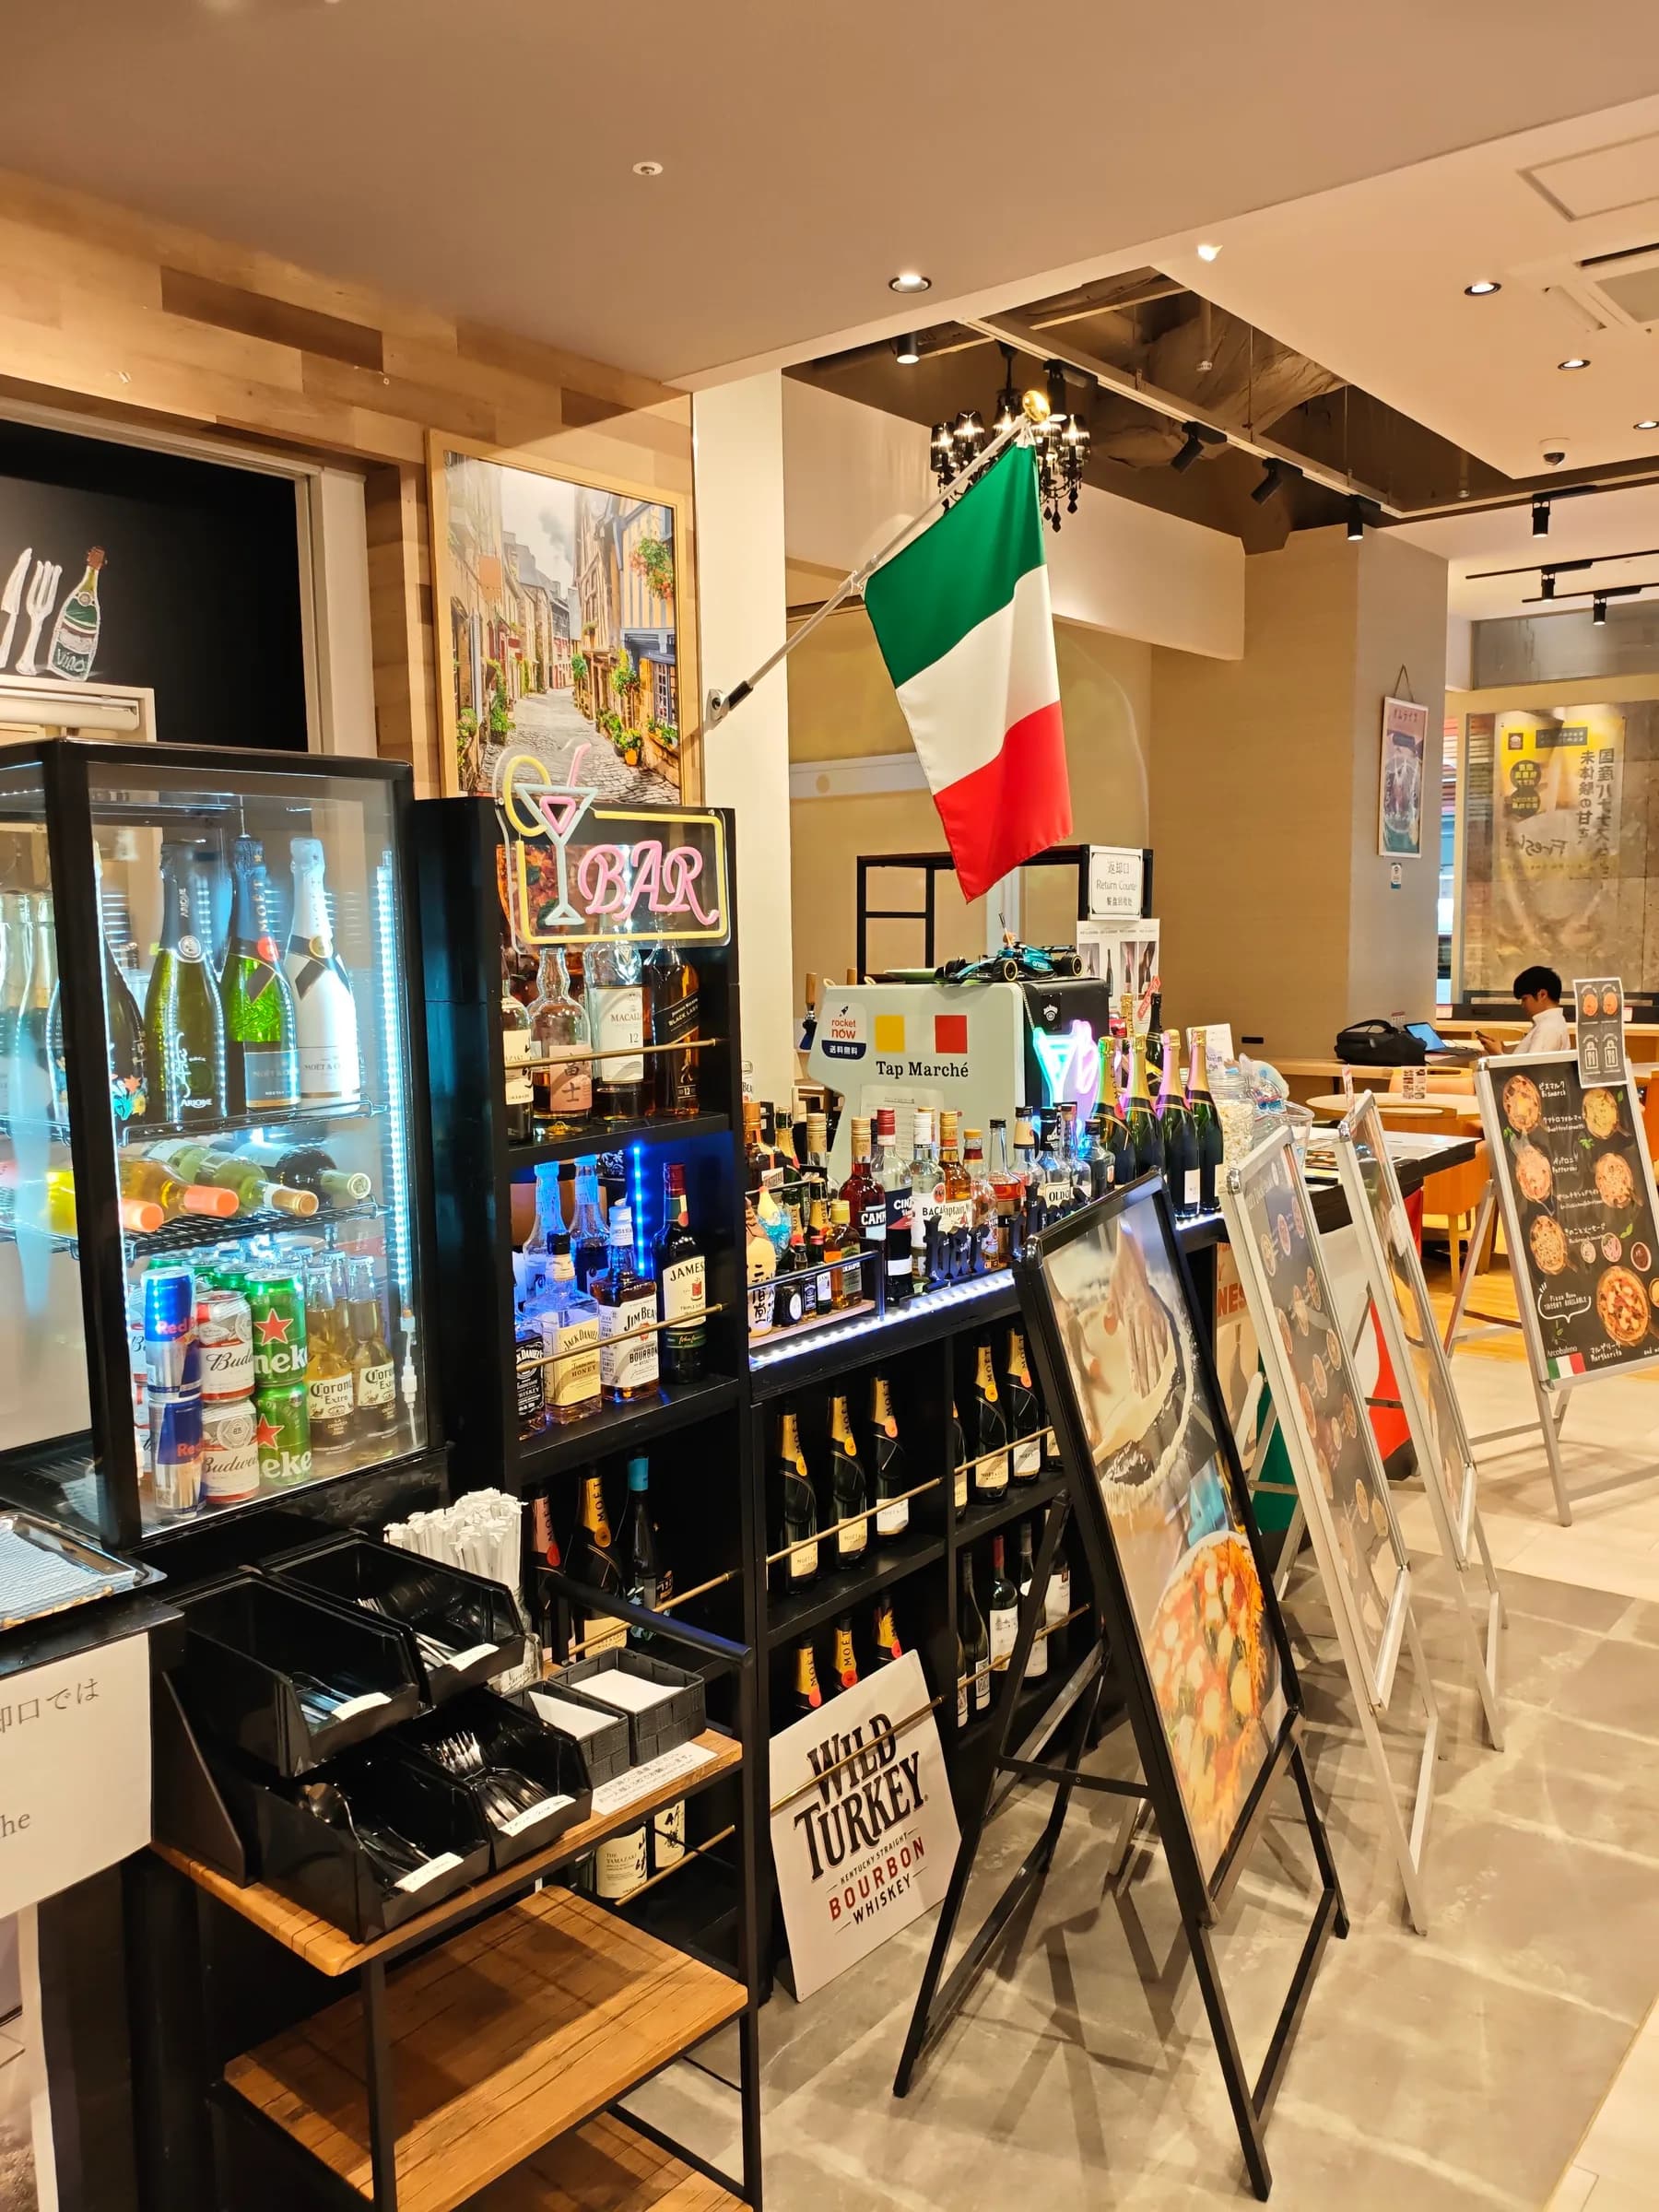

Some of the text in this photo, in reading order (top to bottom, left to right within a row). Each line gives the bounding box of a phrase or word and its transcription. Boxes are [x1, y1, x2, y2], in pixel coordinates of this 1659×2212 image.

[578, 840, 720, 926] BAR
[629, 1032, 639, 1044] 12
[831, 1018, 856, 1028] rocket
[831, 1029, 856, 1040] now
[876, 1061, 969, 1079] Tap Marché
[806, 1712, 897, 1806] WILD
[794, 1751, 925, 1882] TURKEY
[830, 1836, 925, 1921] BOURBON
[840, 1831, 908, 1886] KENTUCKY STRAIGHT
[853, 1873, 912, 1925] WHISKEY
